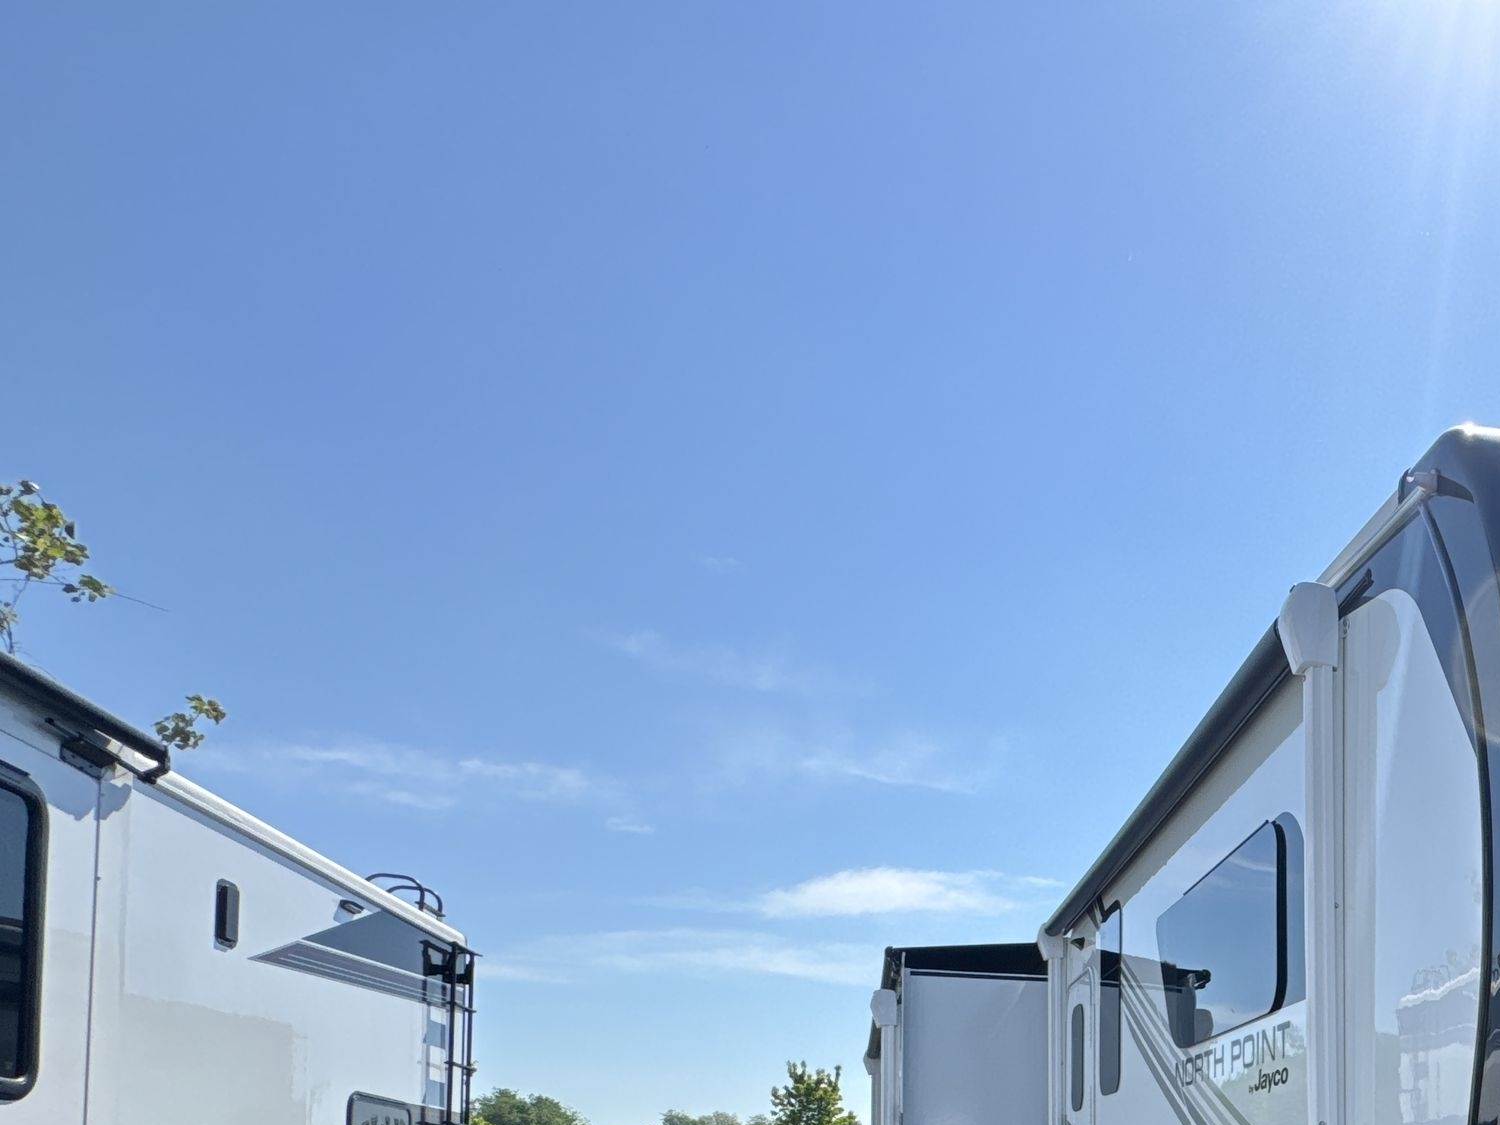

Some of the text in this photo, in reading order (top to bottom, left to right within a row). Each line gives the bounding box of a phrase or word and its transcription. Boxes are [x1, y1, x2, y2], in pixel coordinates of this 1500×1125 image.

[1175, 1021, 1291, 1087] NORTH POINT
[1255, 1067, 1289, 1093] Jayco
